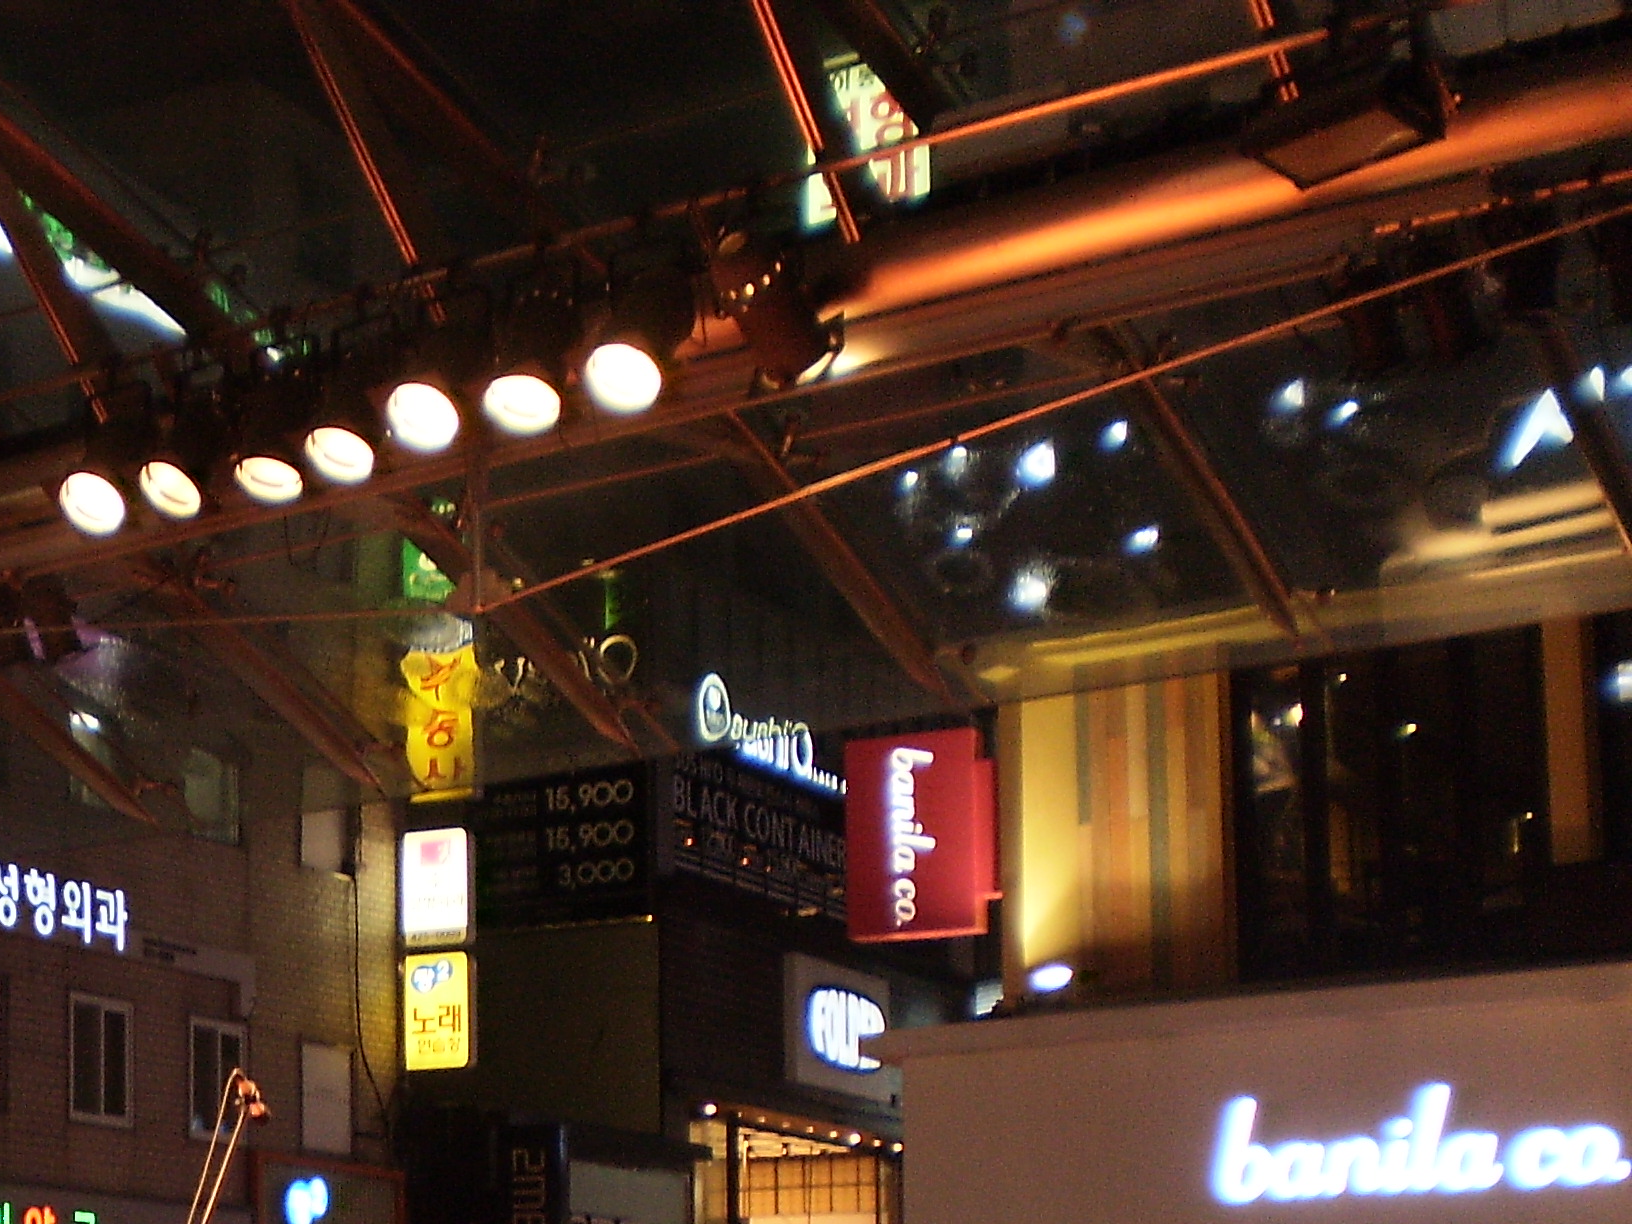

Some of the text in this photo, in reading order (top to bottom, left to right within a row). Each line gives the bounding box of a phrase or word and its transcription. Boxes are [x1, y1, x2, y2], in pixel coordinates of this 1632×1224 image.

[673, 774, 739, 832] BLACK
[743, 802, 847, 870] CONTAINER
[891, 747, 937, 928] banila co.
[412, 1004, 462, 1035] 노래
[1211, 1082, 1504, 1205] banila
